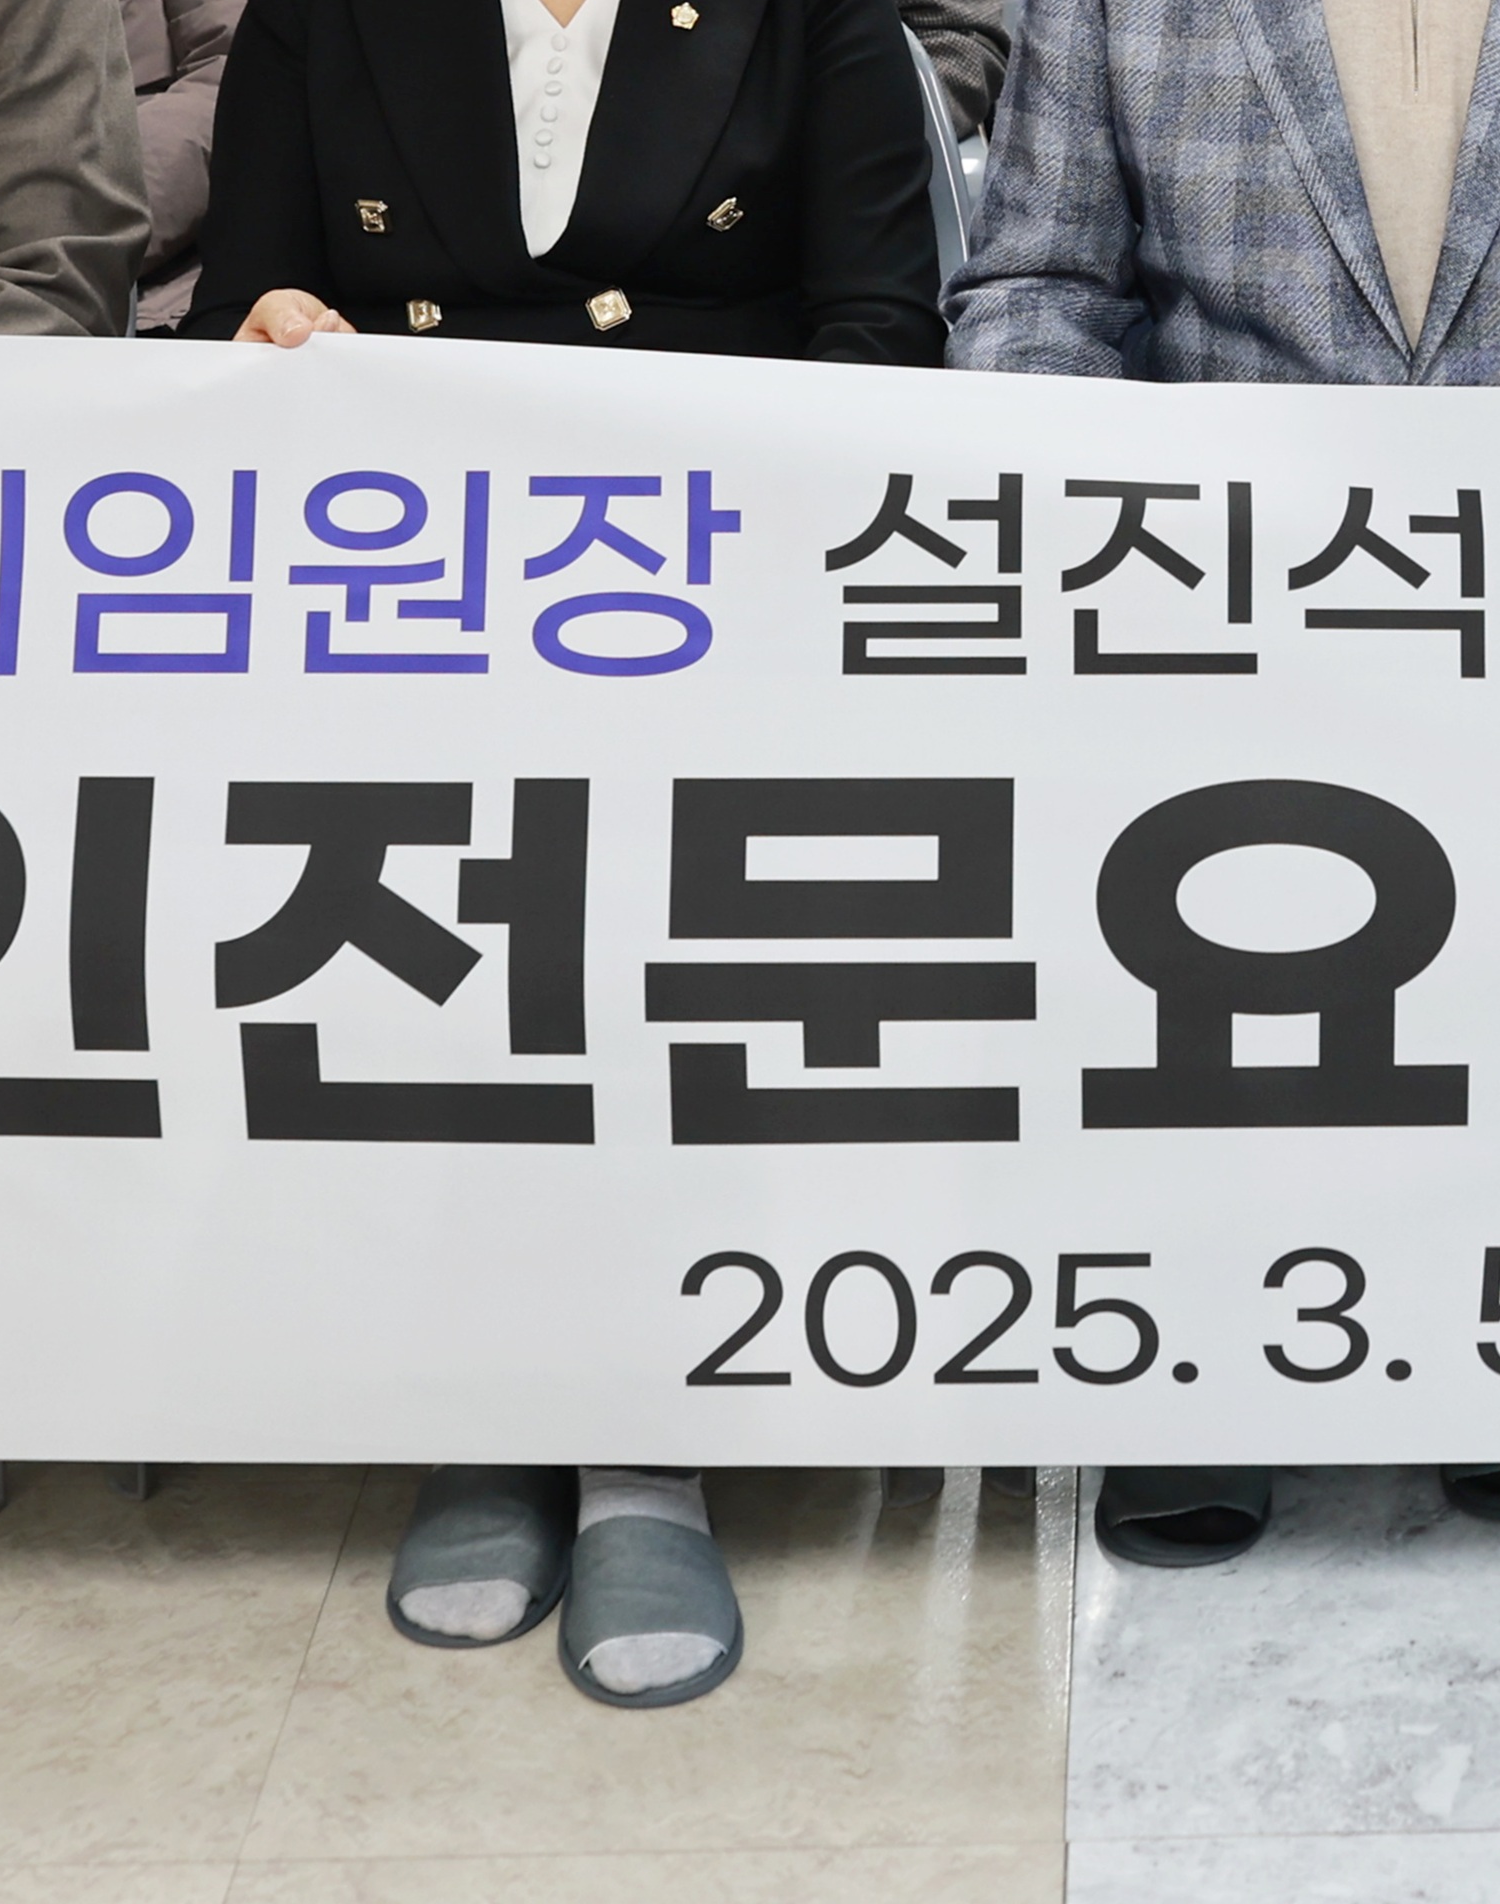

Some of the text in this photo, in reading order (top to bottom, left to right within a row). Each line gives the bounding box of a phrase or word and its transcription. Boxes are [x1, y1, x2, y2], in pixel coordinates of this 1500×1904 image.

[824, 472, 1486, 679] 설진석
[680, 1249, 1200, 1388] 2025.
[1262, 1246, 1414, 1384] 3.
